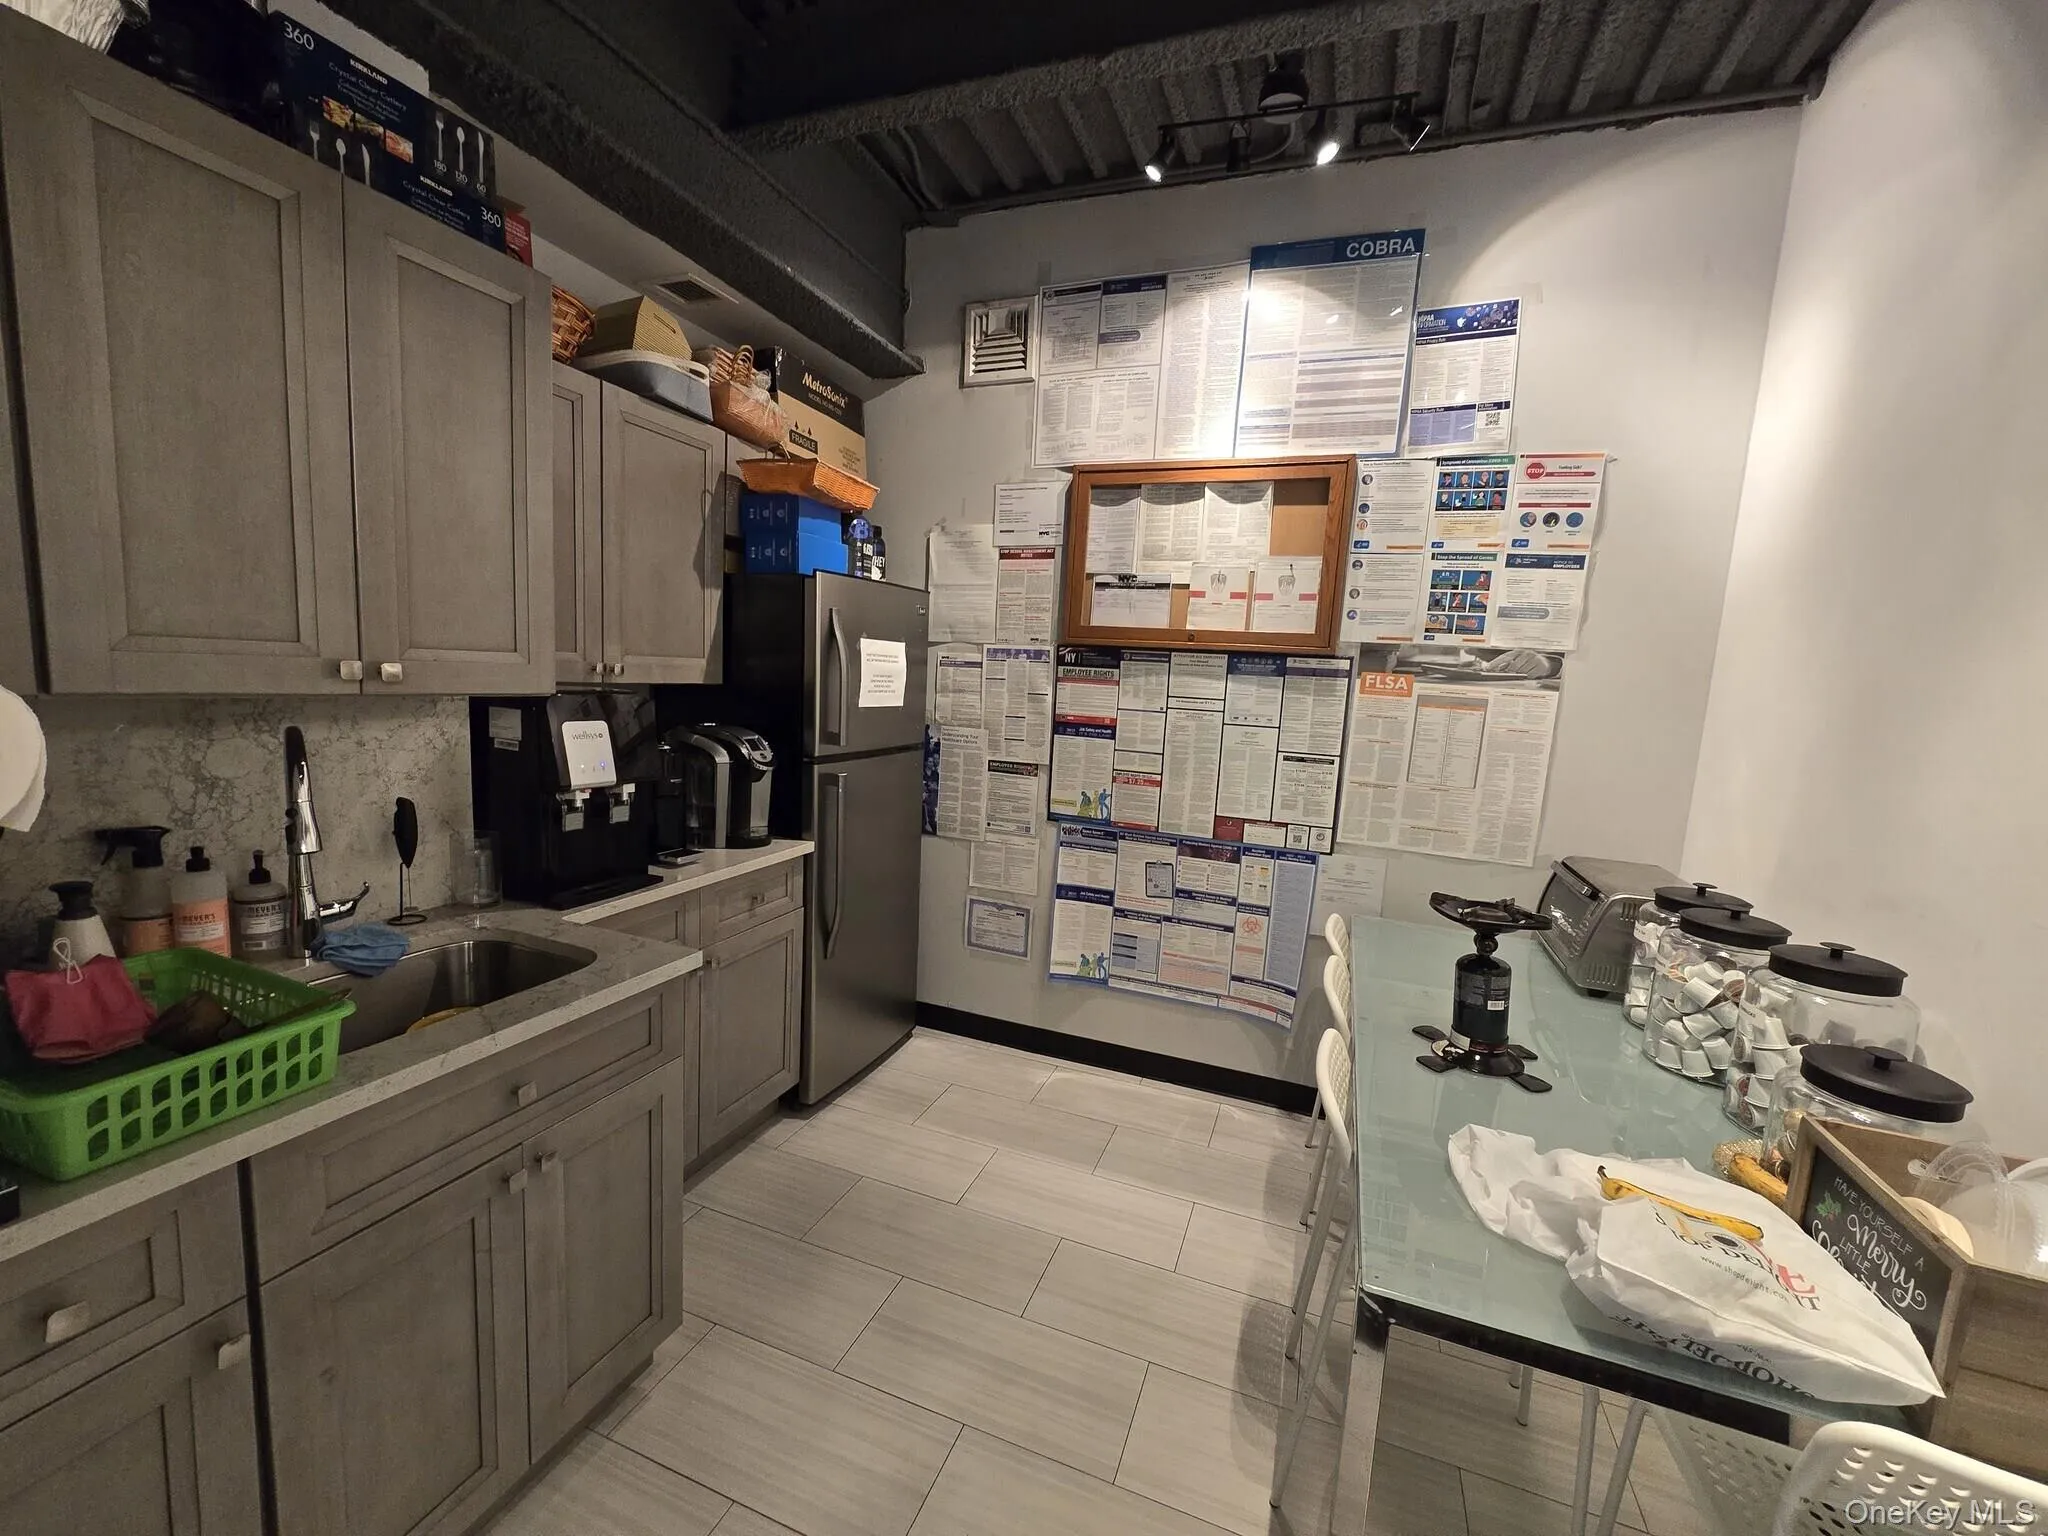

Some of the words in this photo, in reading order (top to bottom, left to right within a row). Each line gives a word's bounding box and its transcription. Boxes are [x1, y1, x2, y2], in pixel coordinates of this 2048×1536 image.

[283, 20, 315, 50] 360
[349, 58, 388, 85] KIRKLAND
[358, 79, 379, 94] Clear
[380, 91, 407, 111] Cutlery
[419, 175, 453, 196] KIRKLAND
[433, 159, 447, 172] 180
[455, 170, 468, 184] 120
[476, 183, 487, 193] 60
[428, 192, 446, 206] Clear
[480, 206, 501, 228] 360
[1346, 237, 1416, 258] COBRA
[802, 372, 846, 408] MetroSonix
[791, 432, 816, 451] FRAGILE
[1527, 467, 1544, 475] STOP
[1118, 573, 1138, 582] NYC
[1064, 652, 1077, 664] NY
[1062, 667, 1092, 676] EMPLOYEE
[1093, 669, 1115, 677] RIGHTS
[1364, 675, 1408, 690] FLSA
[1834, 1177, 1859, 1205] HAVE
[1858, 1200, 1914, 1255] YOURSELF
[1914, 1256, 1925, 1272] A
[1839, 1235, 1873, 1276] LITTLE
[1847, 1214, 1928, 1311] Merry
